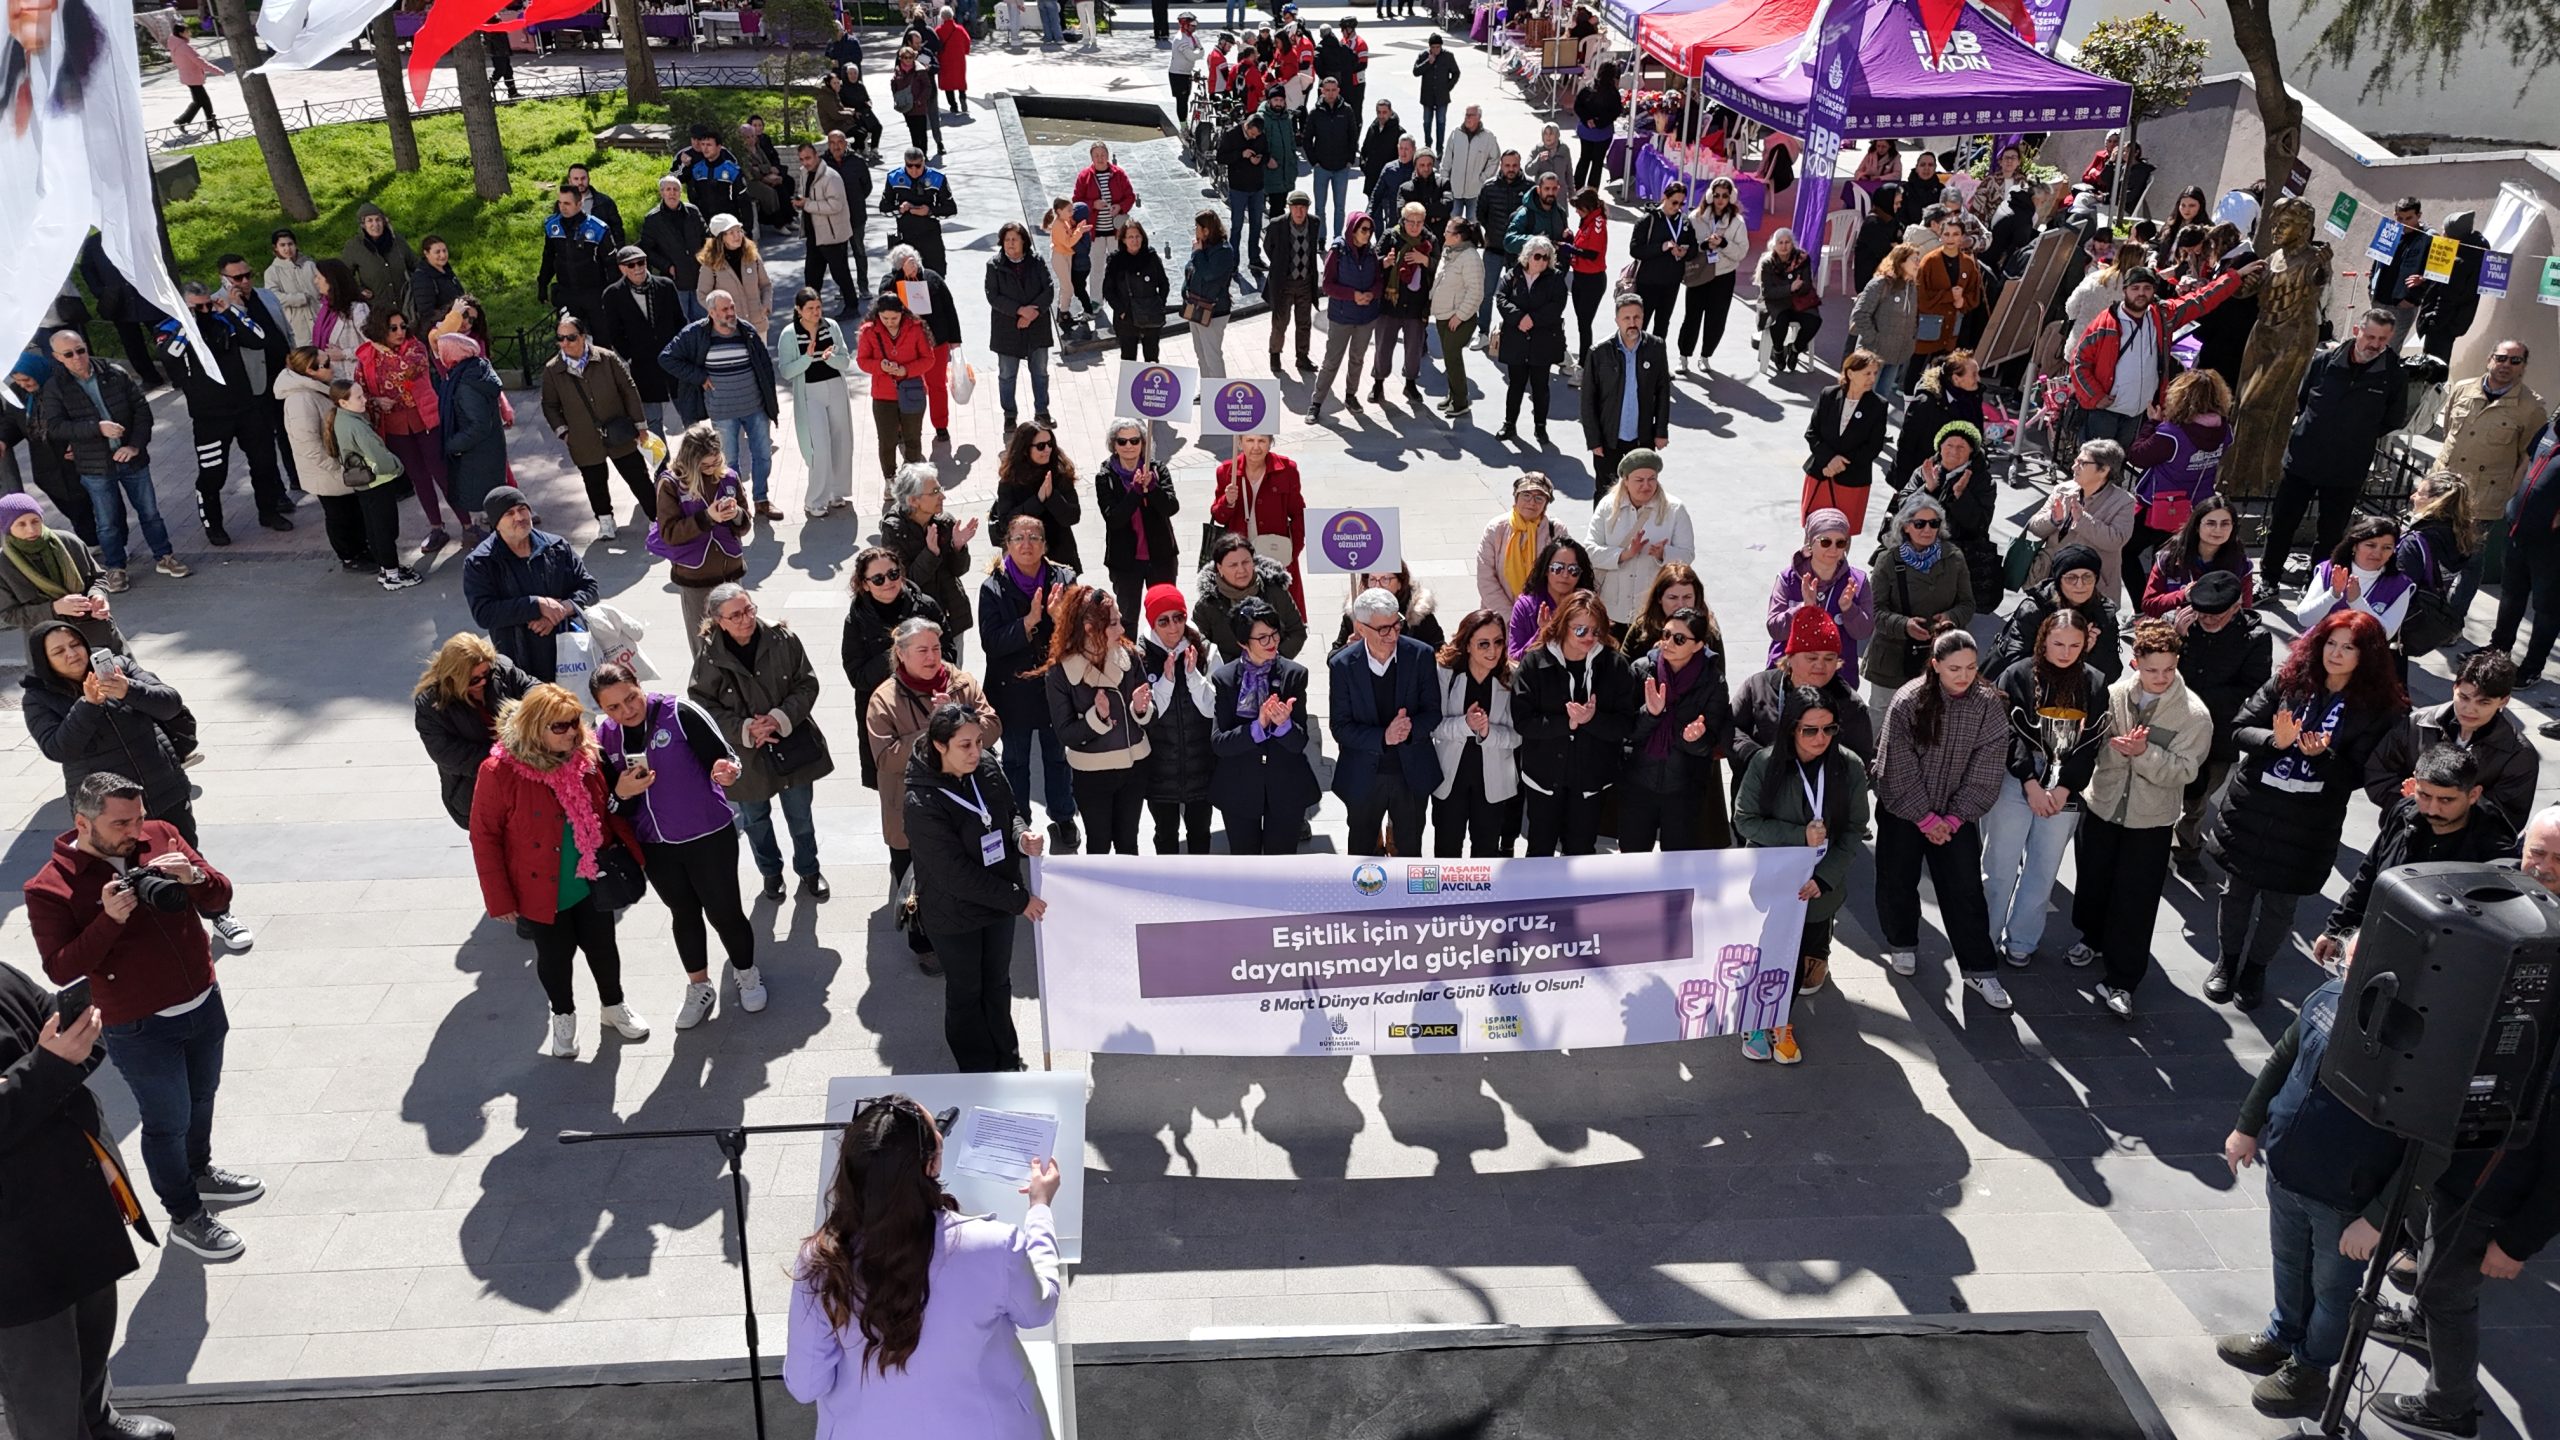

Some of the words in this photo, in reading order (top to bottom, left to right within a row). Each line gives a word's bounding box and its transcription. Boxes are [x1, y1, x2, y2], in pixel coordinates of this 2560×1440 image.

[1441, 865, 1491, 874] YAŞAMIN
[1441, 873, 1491, 882] MERKEZİ
[1441, 882, 1491, 892] AVCILAR
[1272, 922, 1358, 951] Eşitlik
[1362, 919, 1408, 946] için
[1414, 914, 1557, 944] yürüyoruz,
[1231, 950, 1418, 984] dayanışmayla
[1425, 933, 1601, 973] güçleniyoruz!
[1259, 998, 1271, 1012] 8
[1274, 997, 1315, 1012] Mart
[1318, 993, 1370, 1010] Dünya
[1373, 988, 1440, 1006] Kadınlar
[1443, 983, 1486, 999] Günü
[1488, 980, 1531, 997] Kutlu
[1535, 976, 1585, 992] Olsun!
[1488, 1023, 1517, 1031] Bisiklet
[1488, 1031, 1518, 1040] Okulu
